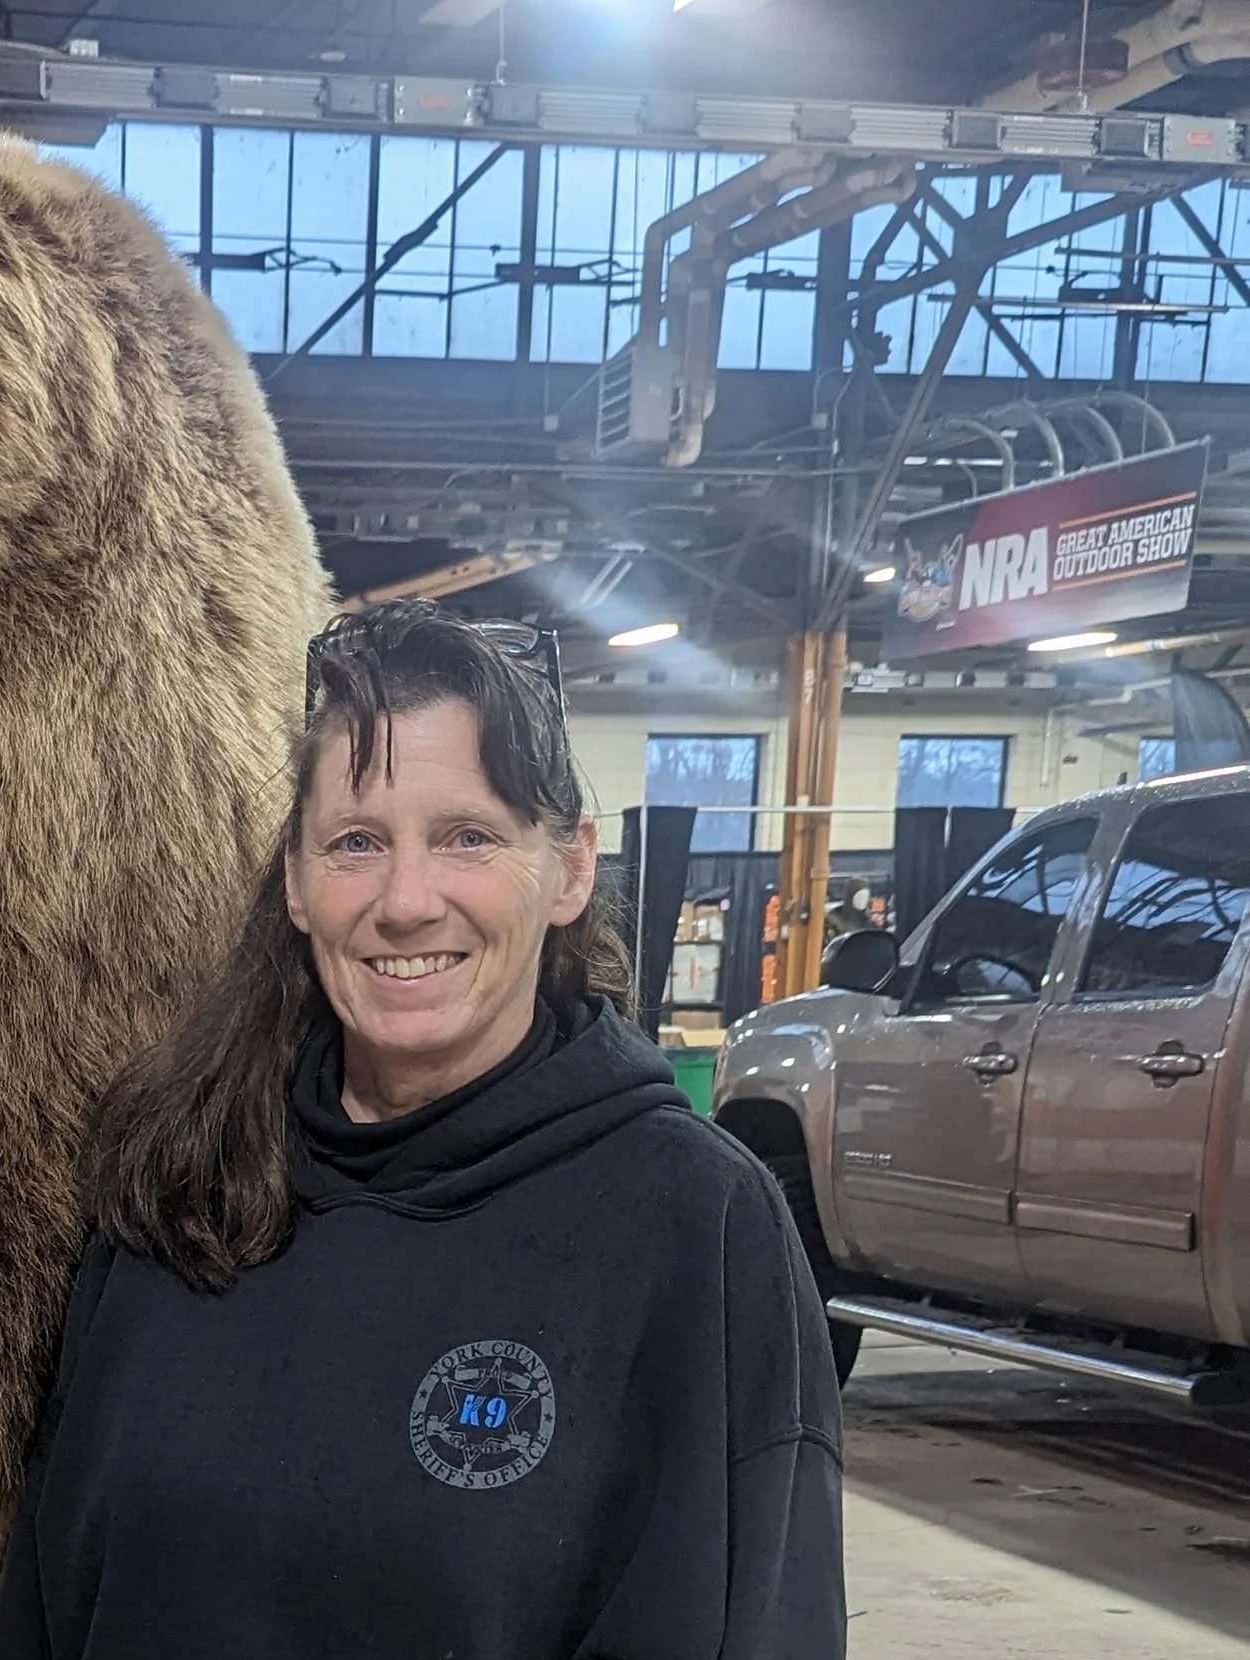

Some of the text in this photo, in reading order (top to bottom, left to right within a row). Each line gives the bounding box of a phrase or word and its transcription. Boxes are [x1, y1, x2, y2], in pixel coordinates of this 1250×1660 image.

[1053, 530, 1192, 581] OUTDOOR SHOW
[1057, 504, 1195, 556] GREAT AMERICAN
[958, 527, 1048, 611] NRA
[430, 1342, 552, 1398] YORK COUNTY
[459, 1394, 507, 1428] K9
[411, 1411, 549, 1487] SHERIFF'S OFFICE
